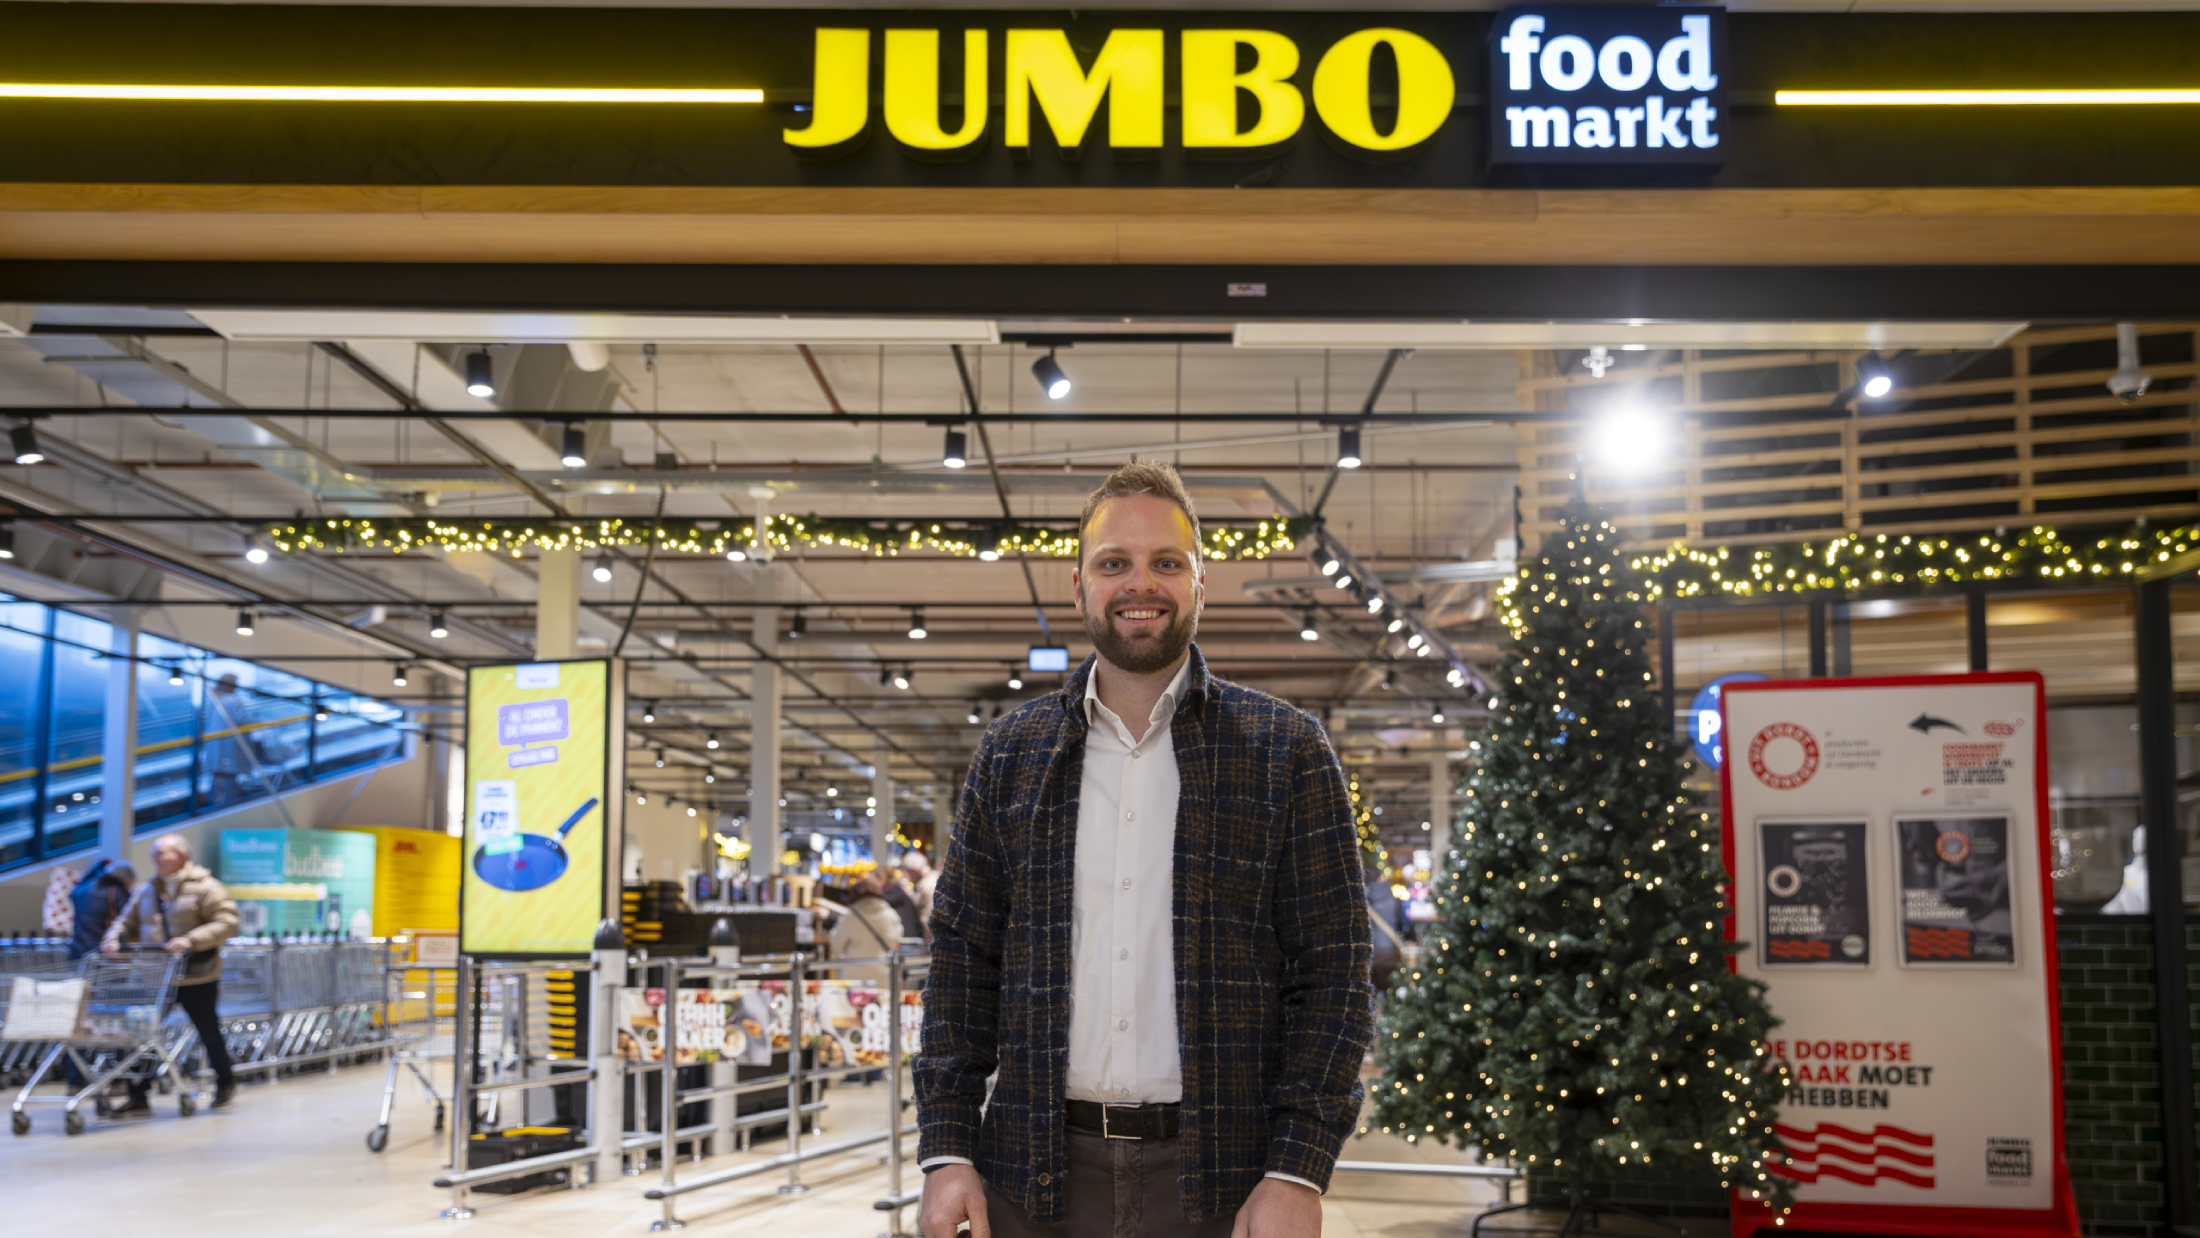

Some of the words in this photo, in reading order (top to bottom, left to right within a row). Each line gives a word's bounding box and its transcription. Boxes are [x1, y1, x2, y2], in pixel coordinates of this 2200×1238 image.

[1501, 14, 1718, 91] food
[783, 27, 1455, 150] JUMBO
[1506, 95, 1719, 148] markt
[1794, 1040, 1912, 1062] DORDTSE
[1858, 1065, 1933, 1087] MOET
[1788, 1086, 1890, 1110] HEBBEN
